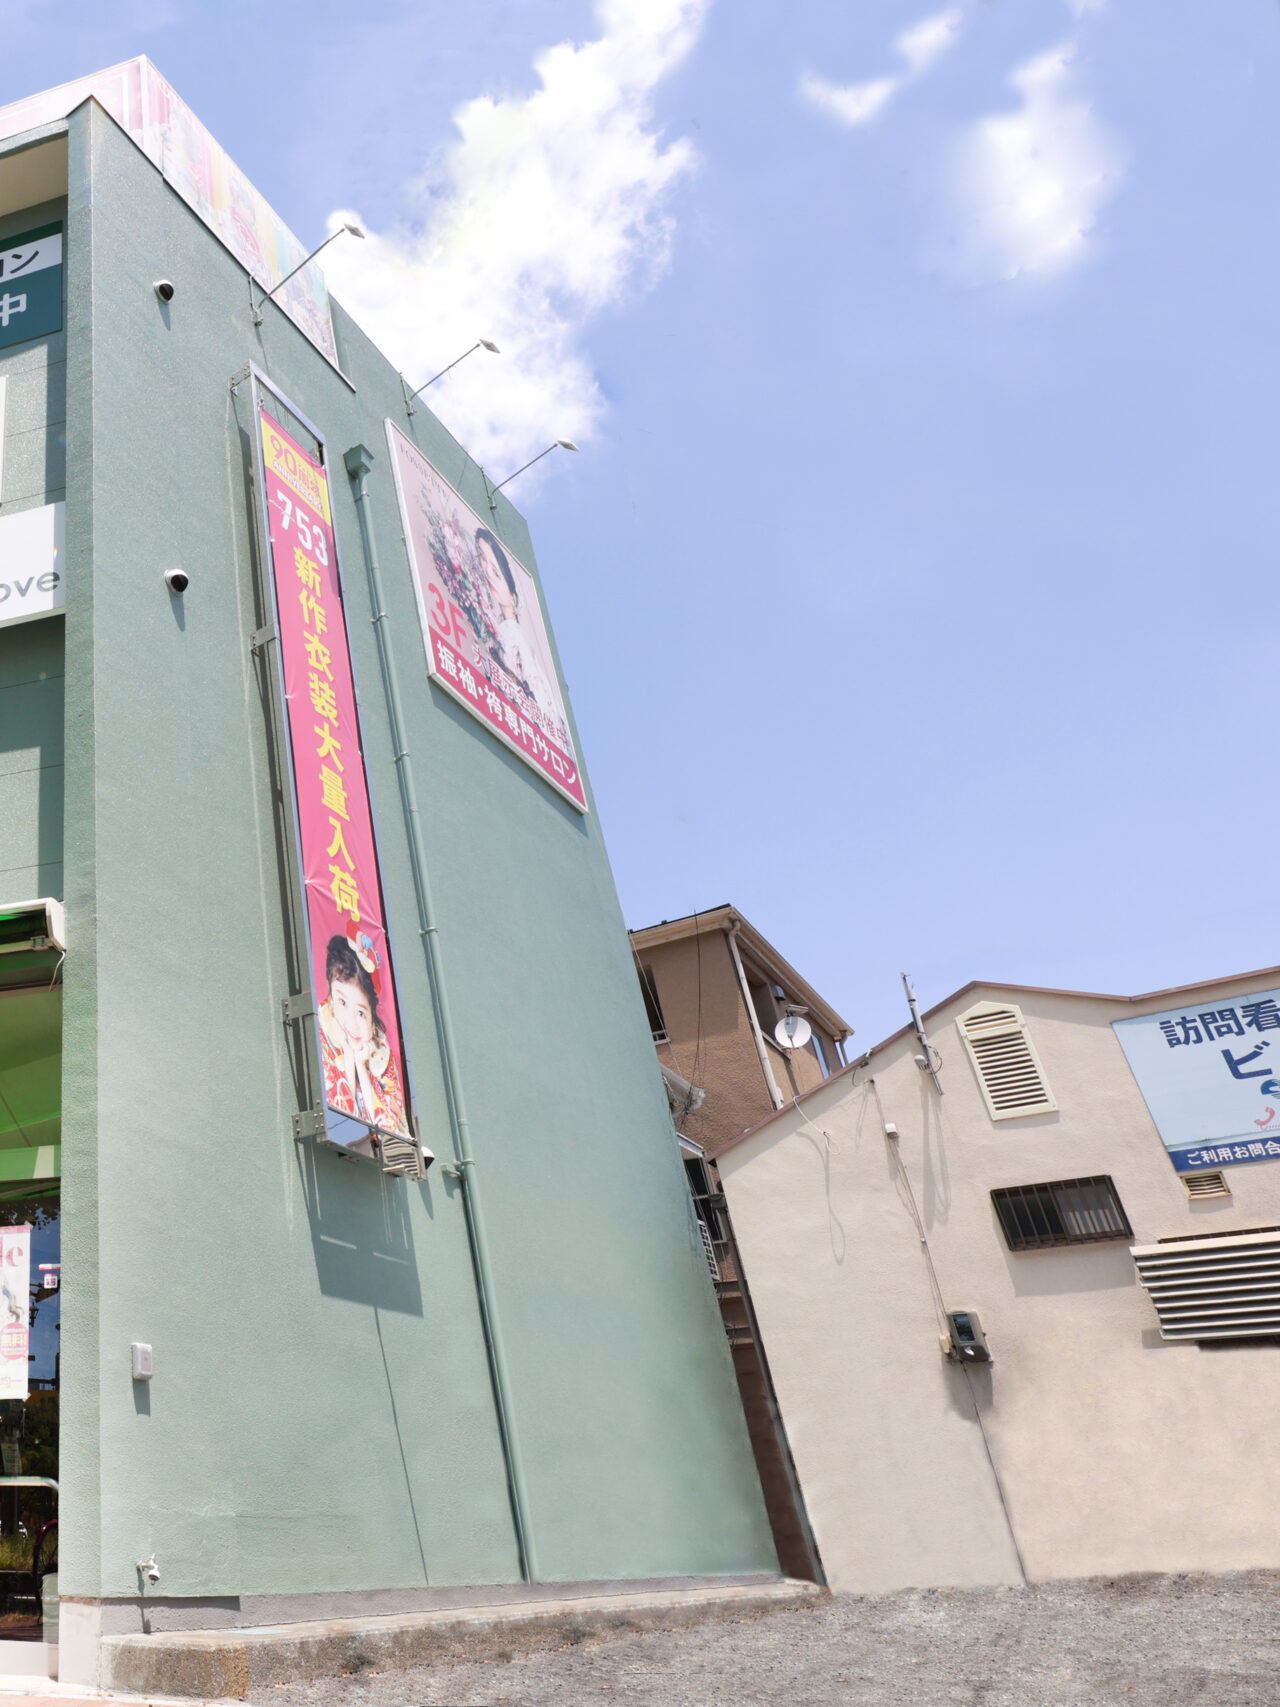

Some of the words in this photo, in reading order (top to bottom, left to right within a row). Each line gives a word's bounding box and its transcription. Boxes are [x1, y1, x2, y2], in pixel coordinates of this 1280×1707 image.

[276, 488, 329, 566] 753
[428, 582, 468, 649] 3F
[292, 546, 360, 923] 新作衣装大量入荷
[436, 639, 577, 785] 振袖・袴専門サロン
[1159, 998, 1280, 1049] 訪問看
[1220, 1040, 1274, 1080] ビ
